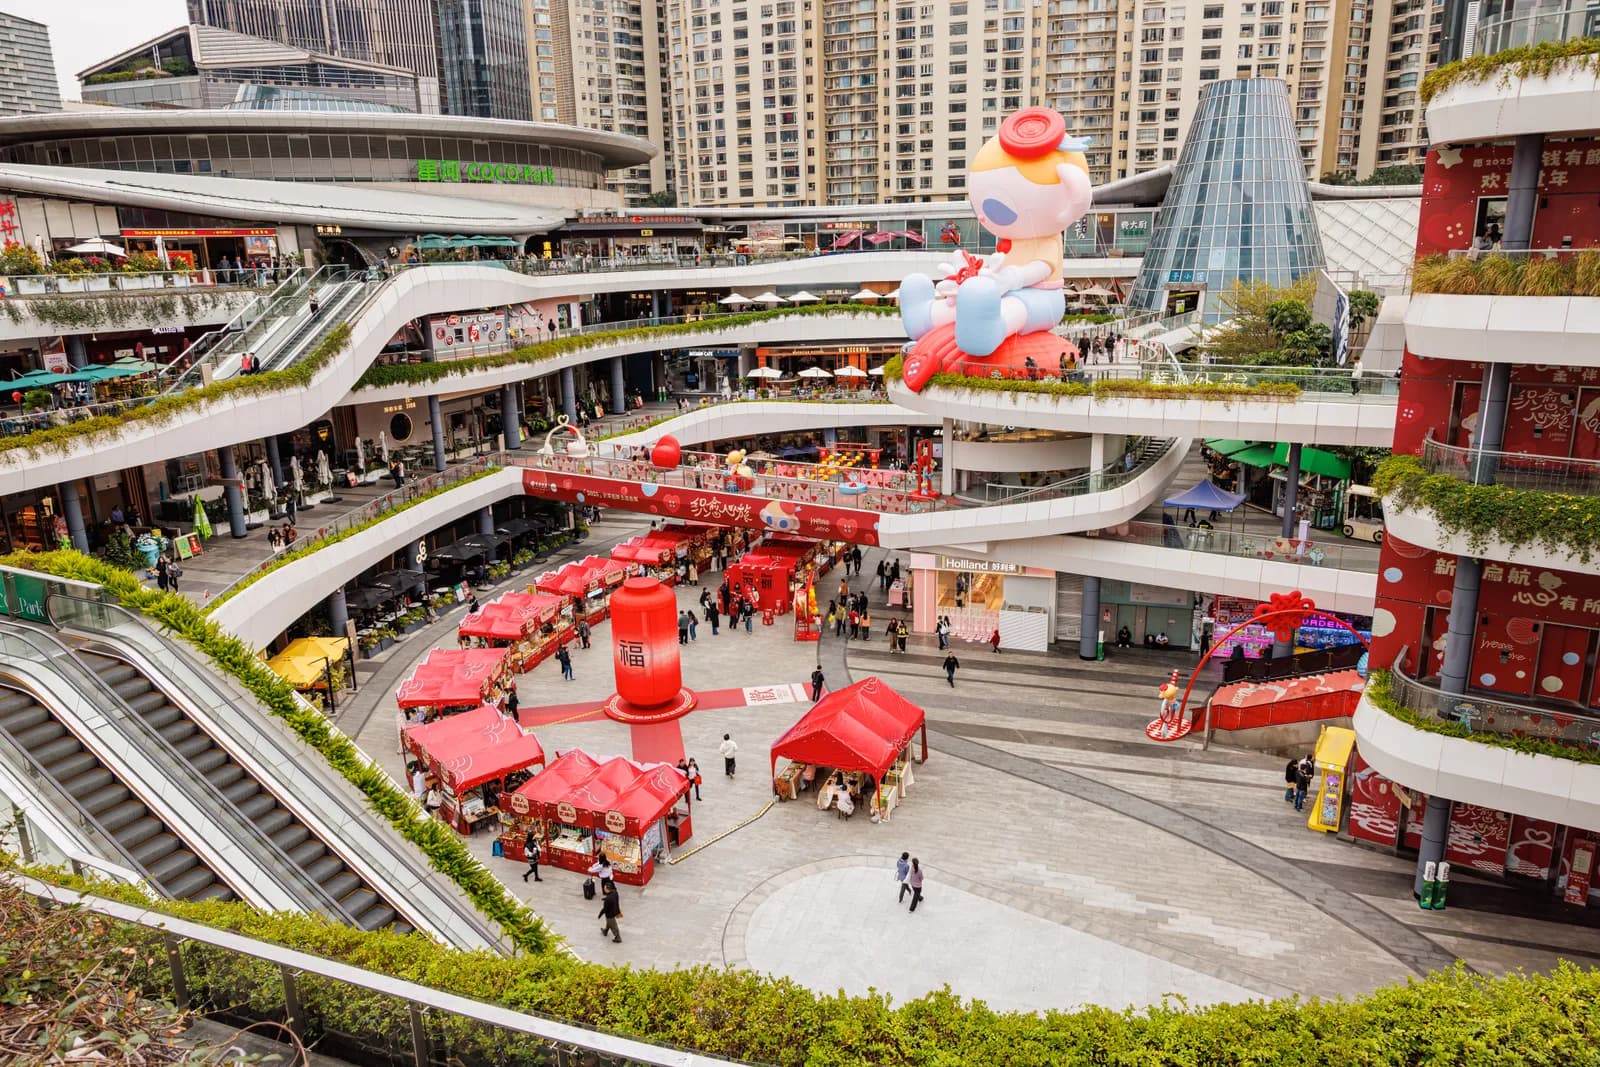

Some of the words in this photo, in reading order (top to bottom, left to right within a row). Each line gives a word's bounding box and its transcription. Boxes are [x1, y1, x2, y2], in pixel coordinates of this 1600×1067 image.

[418, 160, 459, 181] 星河
[467, 162, 519, 181] COCO
[522, 164, 555, 184] Park
[19, 597, 45, 617] Park
[620, 639, 646, 668] 福
